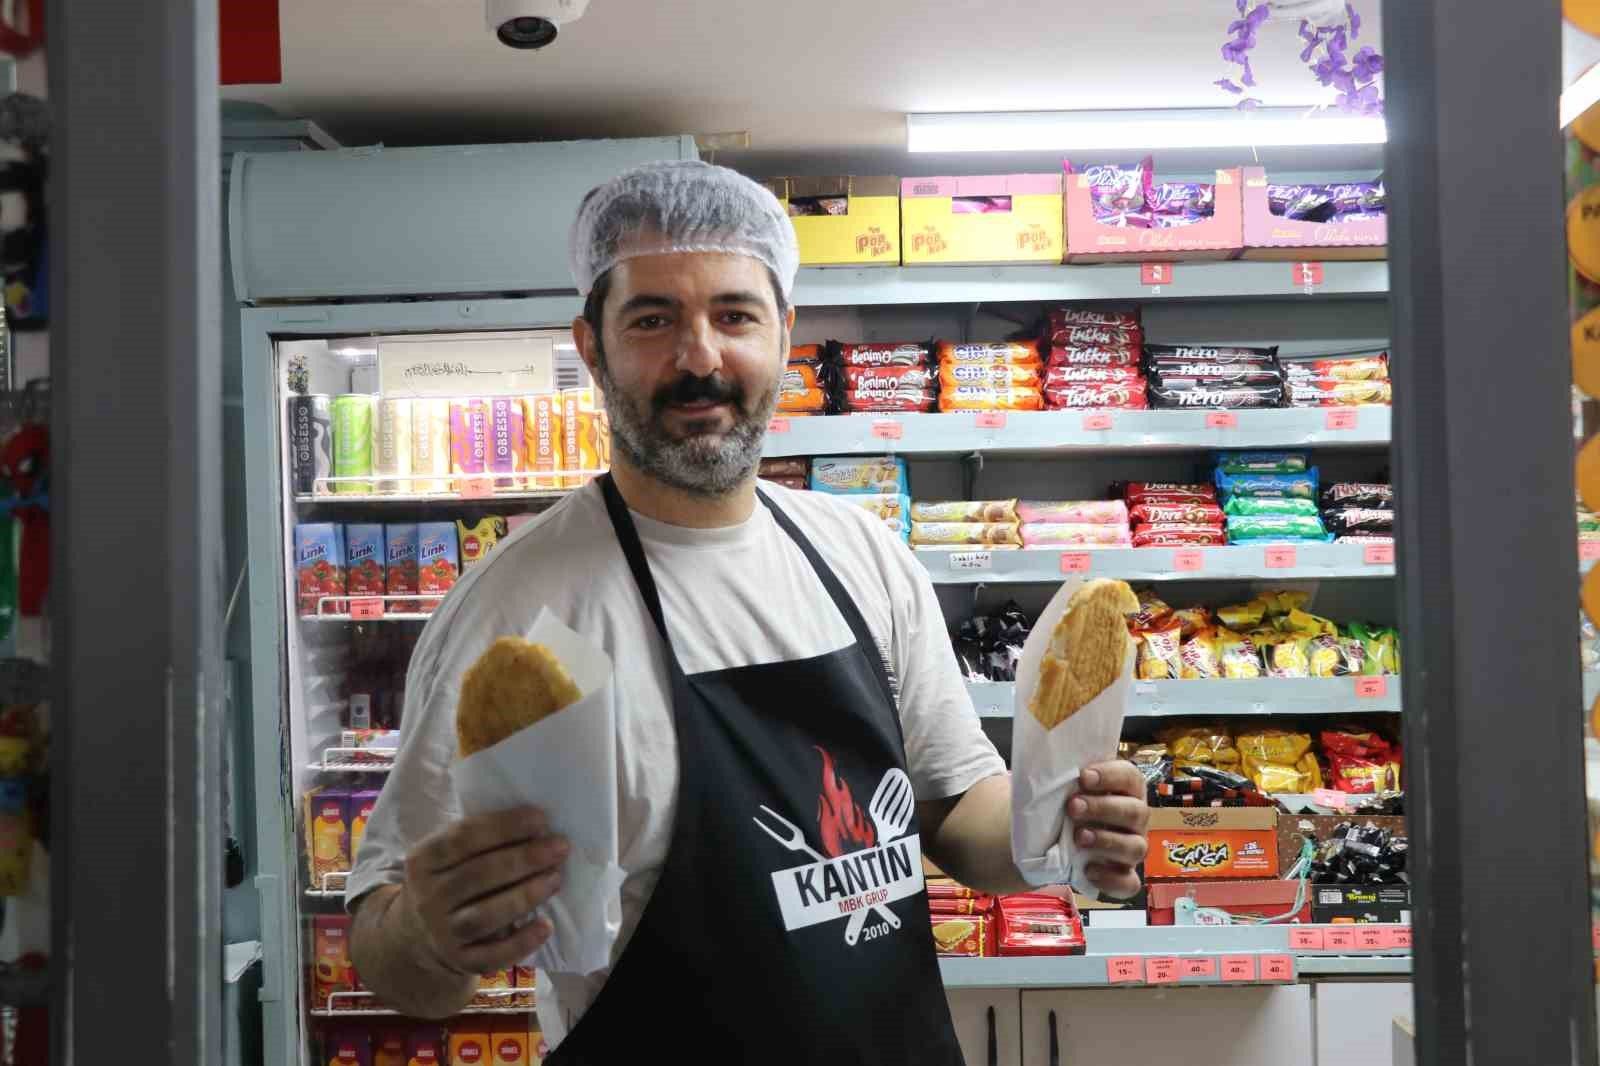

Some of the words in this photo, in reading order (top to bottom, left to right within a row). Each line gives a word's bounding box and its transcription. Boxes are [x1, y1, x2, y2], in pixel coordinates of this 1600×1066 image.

[1175, 347, 1218, 359] nero
[1180, 364, 1224, 376] nero
[1179, 391, 1224, 405] nero
[299, 405, 310, 462] OBSESSO
[496, 400, 509, 456] OBSESSO
[538, 400, 550, 456] OBSESSO
[300, 543, 327, 561] Link
[349, 543, 376, 561] Link
[420, 543, 447, 560] Link
[1171, 843, 1228, 866] CANGA
[794, 841, 913, 908] KANTİN
[838, 898, 865, 914] MBK
[866, 888, 889, 906] GRUP
[863, 921, 890, 942] 2010
